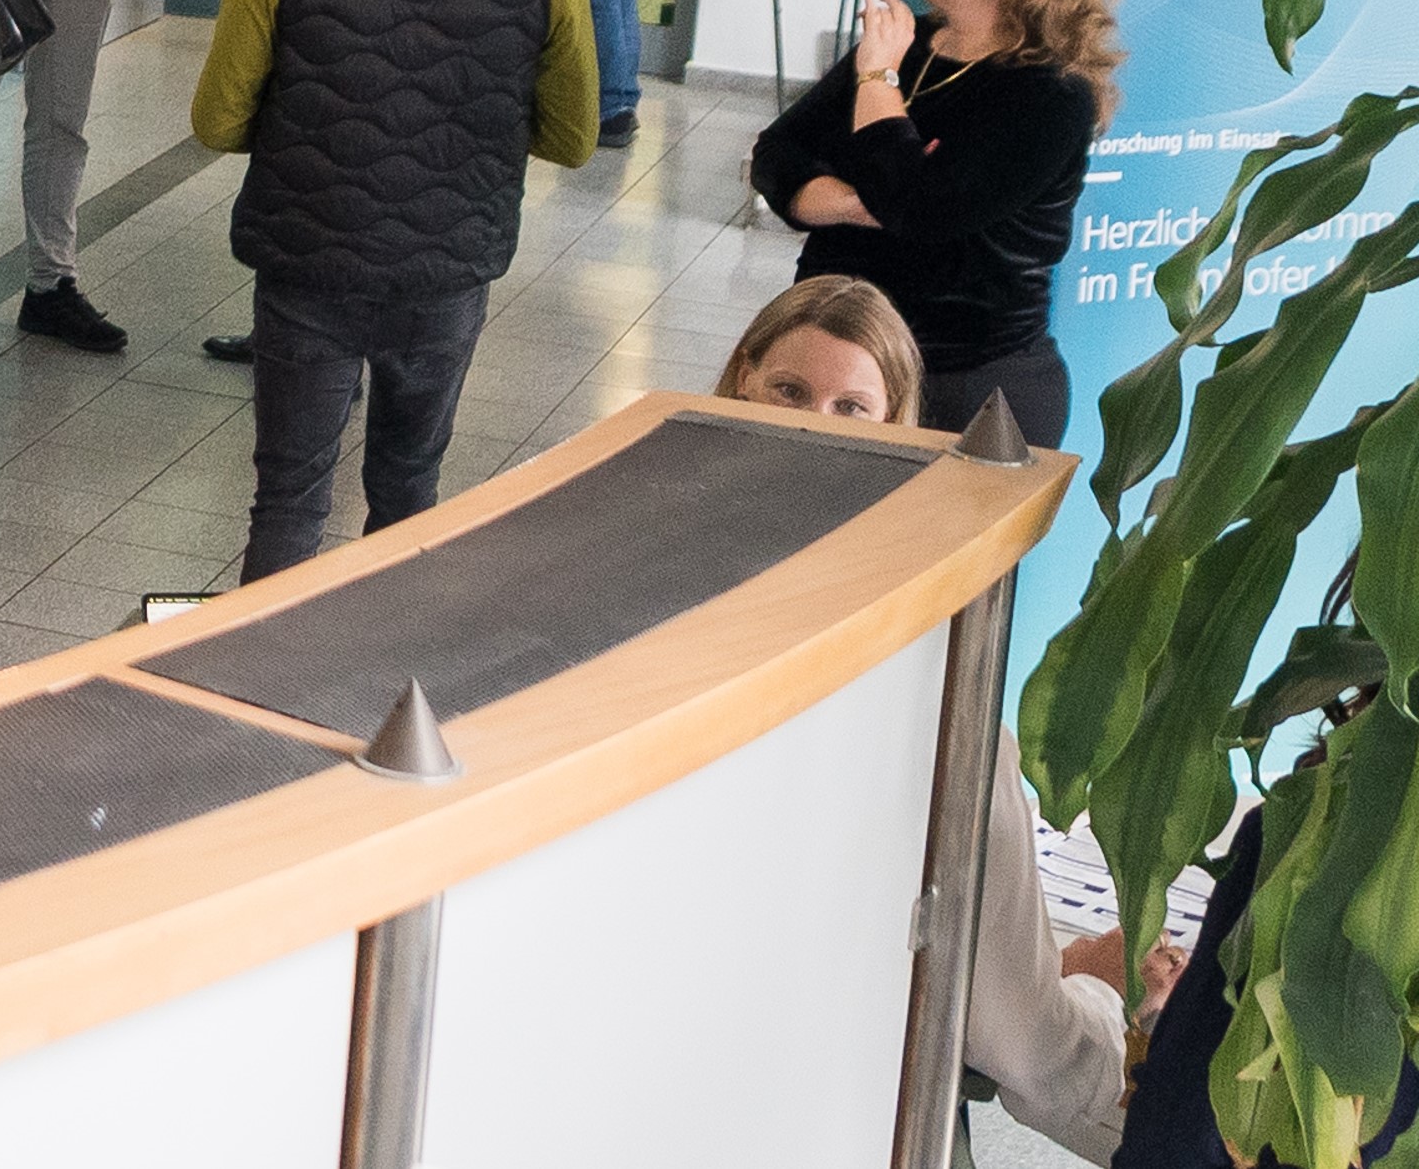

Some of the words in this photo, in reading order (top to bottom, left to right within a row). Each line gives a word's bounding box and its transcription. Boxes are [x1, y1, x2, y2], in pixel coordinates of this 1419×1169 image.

[1188, 129, 1212, 149] im
[1219, 128, 1287, 149] Einsat
[1082, 207, 1211, 251] Herzlich
[1077, 266, 1117, 303] im
[1129, 255, 1315, 298] Frnofer
